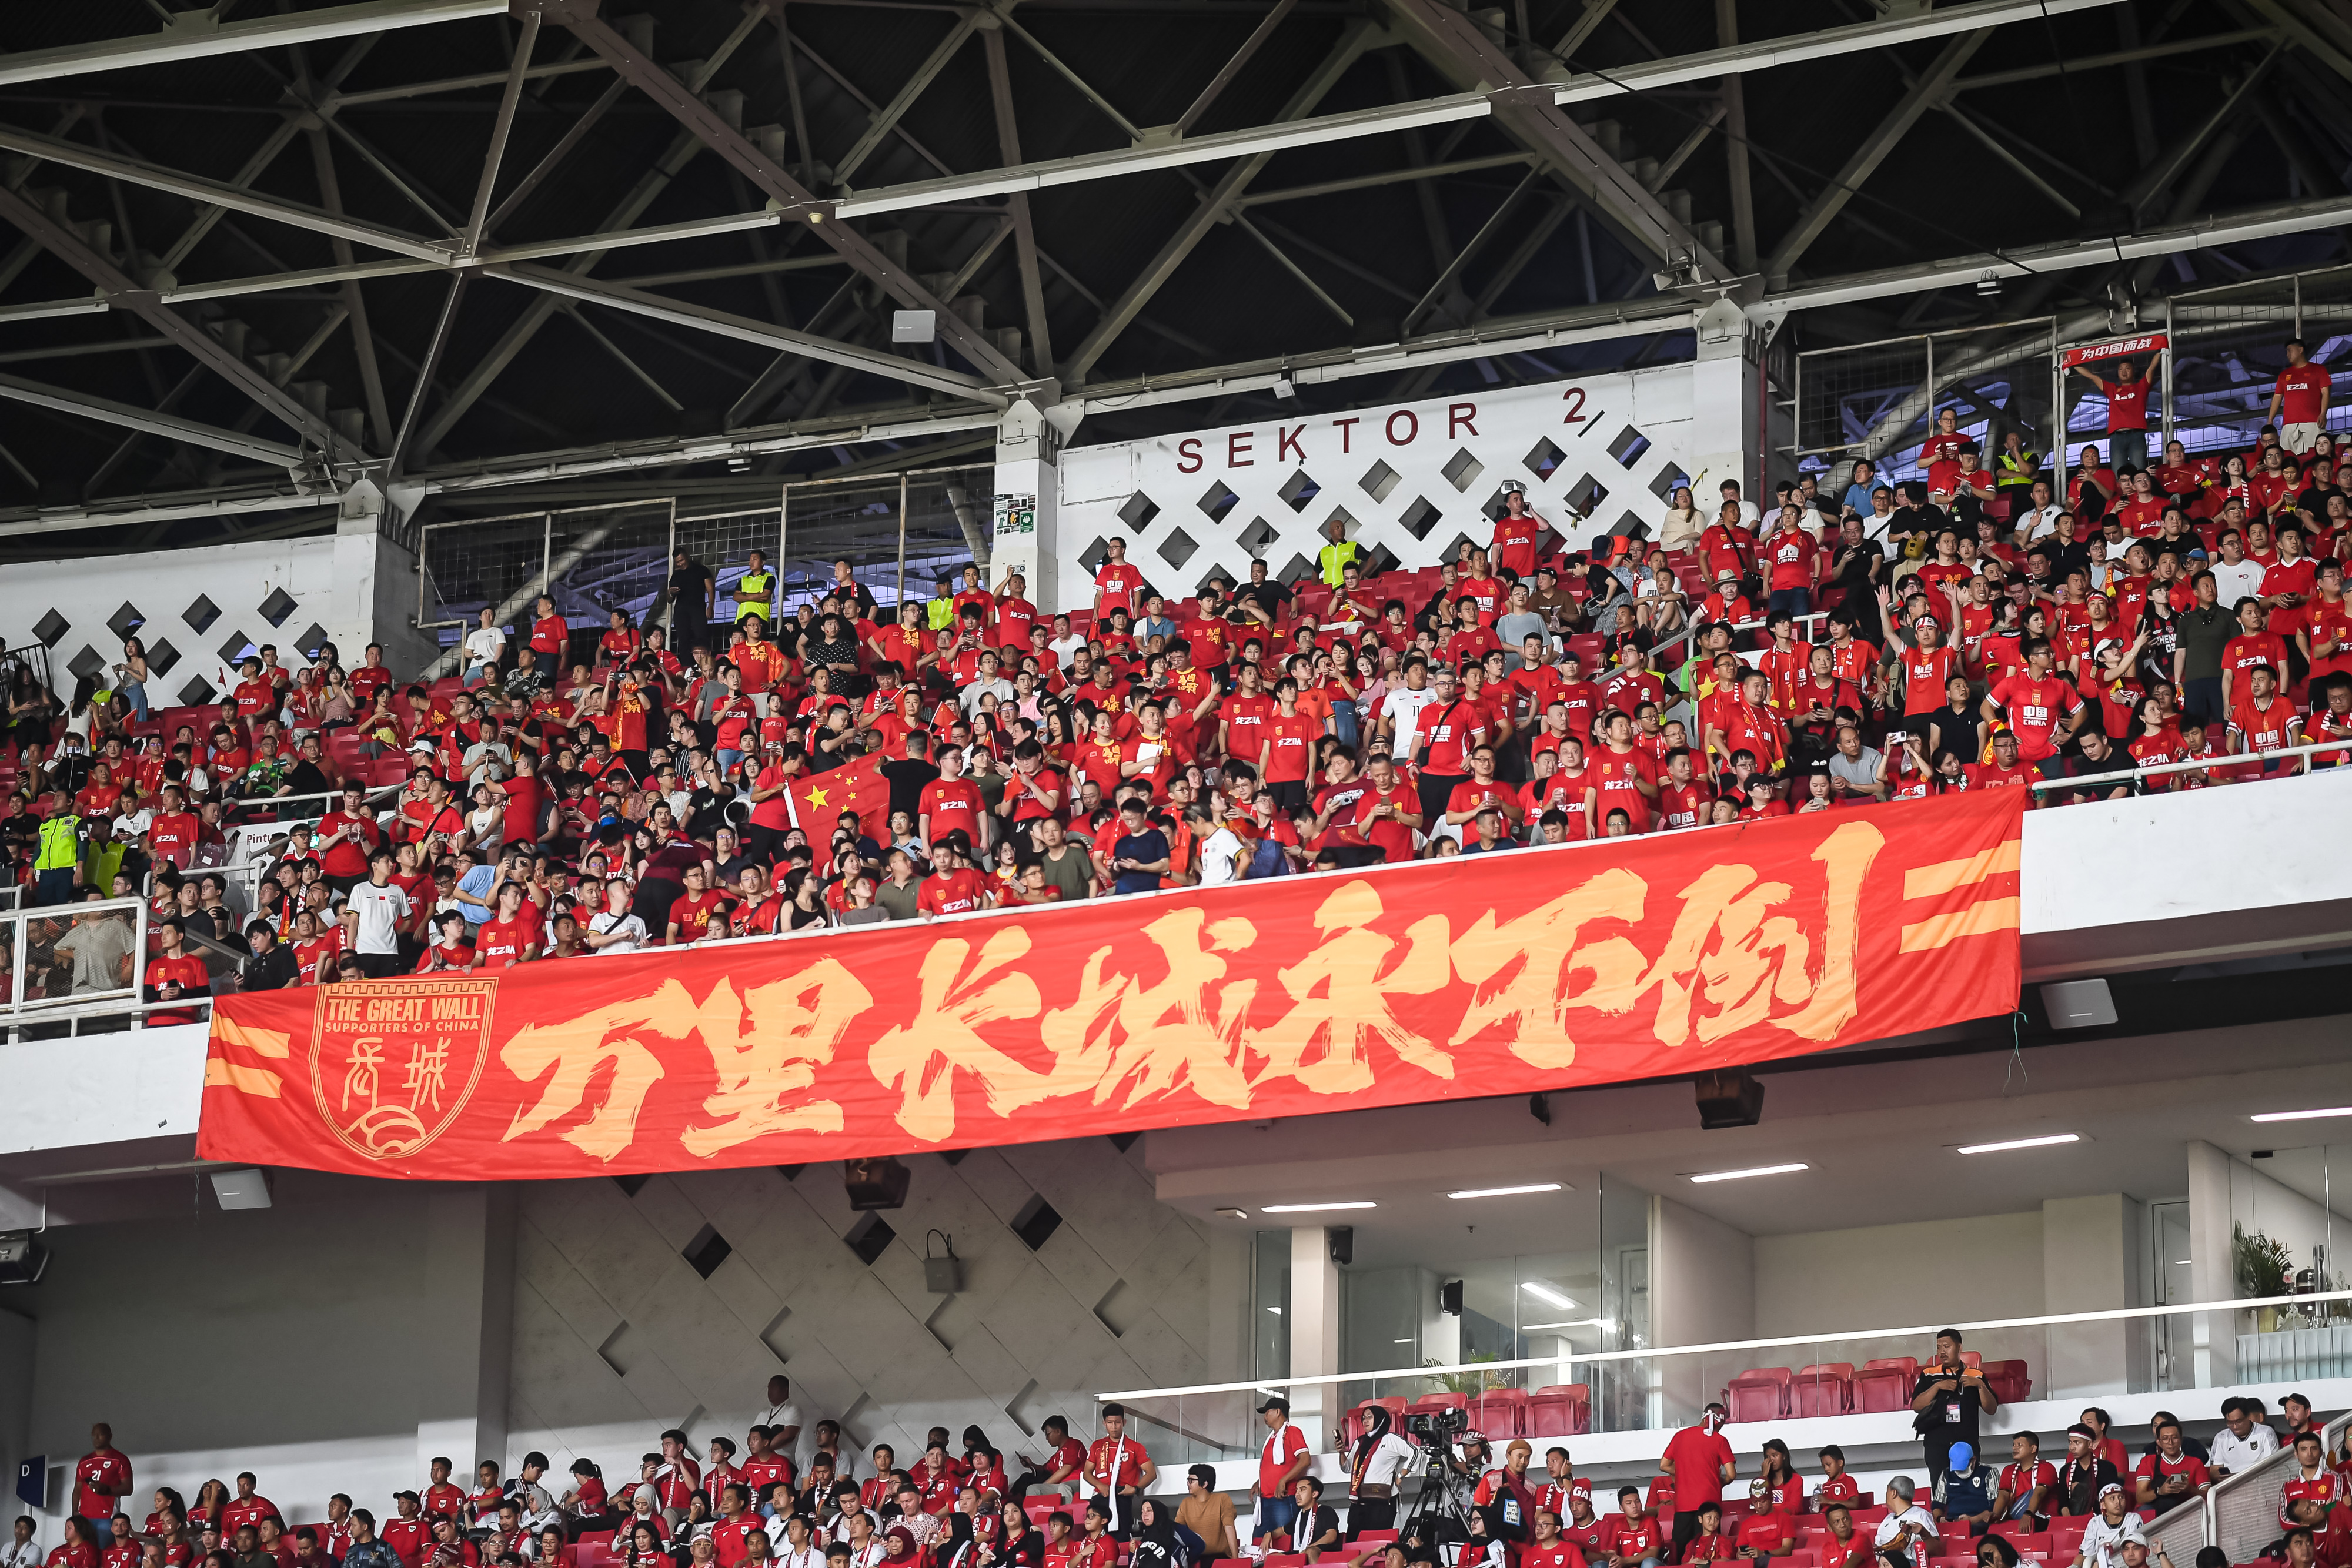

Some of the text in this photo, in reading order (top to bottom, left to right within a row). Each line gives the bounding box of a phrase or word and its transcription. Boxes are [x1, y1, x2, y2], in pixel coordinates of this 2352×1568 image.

[2080, 338, 2153, 360] 为中国而战
[1177, 387, 1587, 473] SEKTOR 2
[1506, 537, 1529, 546] 龙之队
[1914, 662, 1933, 674] 中国
[2237, 656, 2267, 669] 龙之队
[2023, 706, 2047, 717] 中国
[2255, 730, 2278, 744] 中国
[2138, 754, 2169, 768] 龙之队
[1604, 781, 1633, 790] 龙之队
[940, 801, 968, 811] 龙之队
[1669, 811, 1695, 825] 中国
[941, 899, 971, 913] 龙之队
[487, 945, 515, 955] 龙之队
[499, 821, 1886, 1163] 万里长城永不倒
[329, 997, 481, 1021] THE GREAT WALL
[325, 1021, 479, 1033] SUPPORTERS OF CHINA
[22, 1465, 29, 1476] D
[92, 1470, 101, 1481] 21
